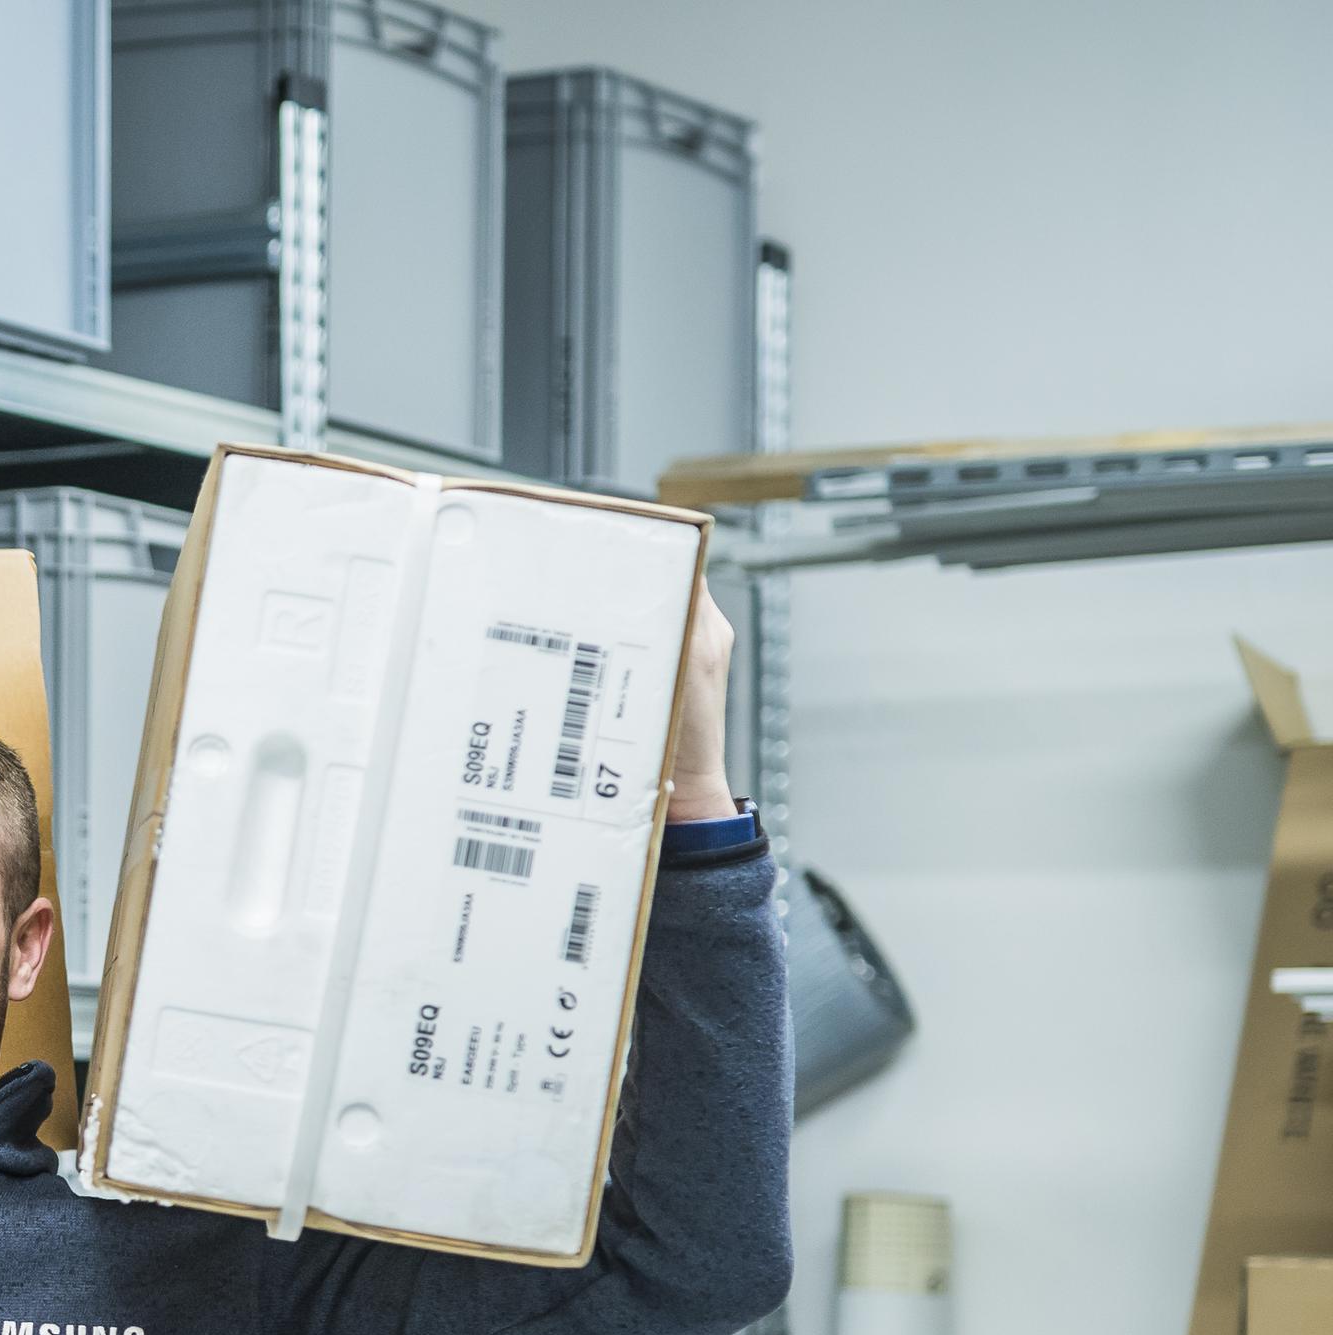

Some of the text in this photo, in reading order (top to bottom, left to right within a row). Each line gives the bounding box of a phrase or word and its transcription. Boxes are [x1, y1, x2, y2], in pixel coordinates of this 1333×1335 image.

[463, 720, 493, 786] S09EQ
[595, 763, 622, 798] 67
[410, 1004, 441, 1076] S09EQ
